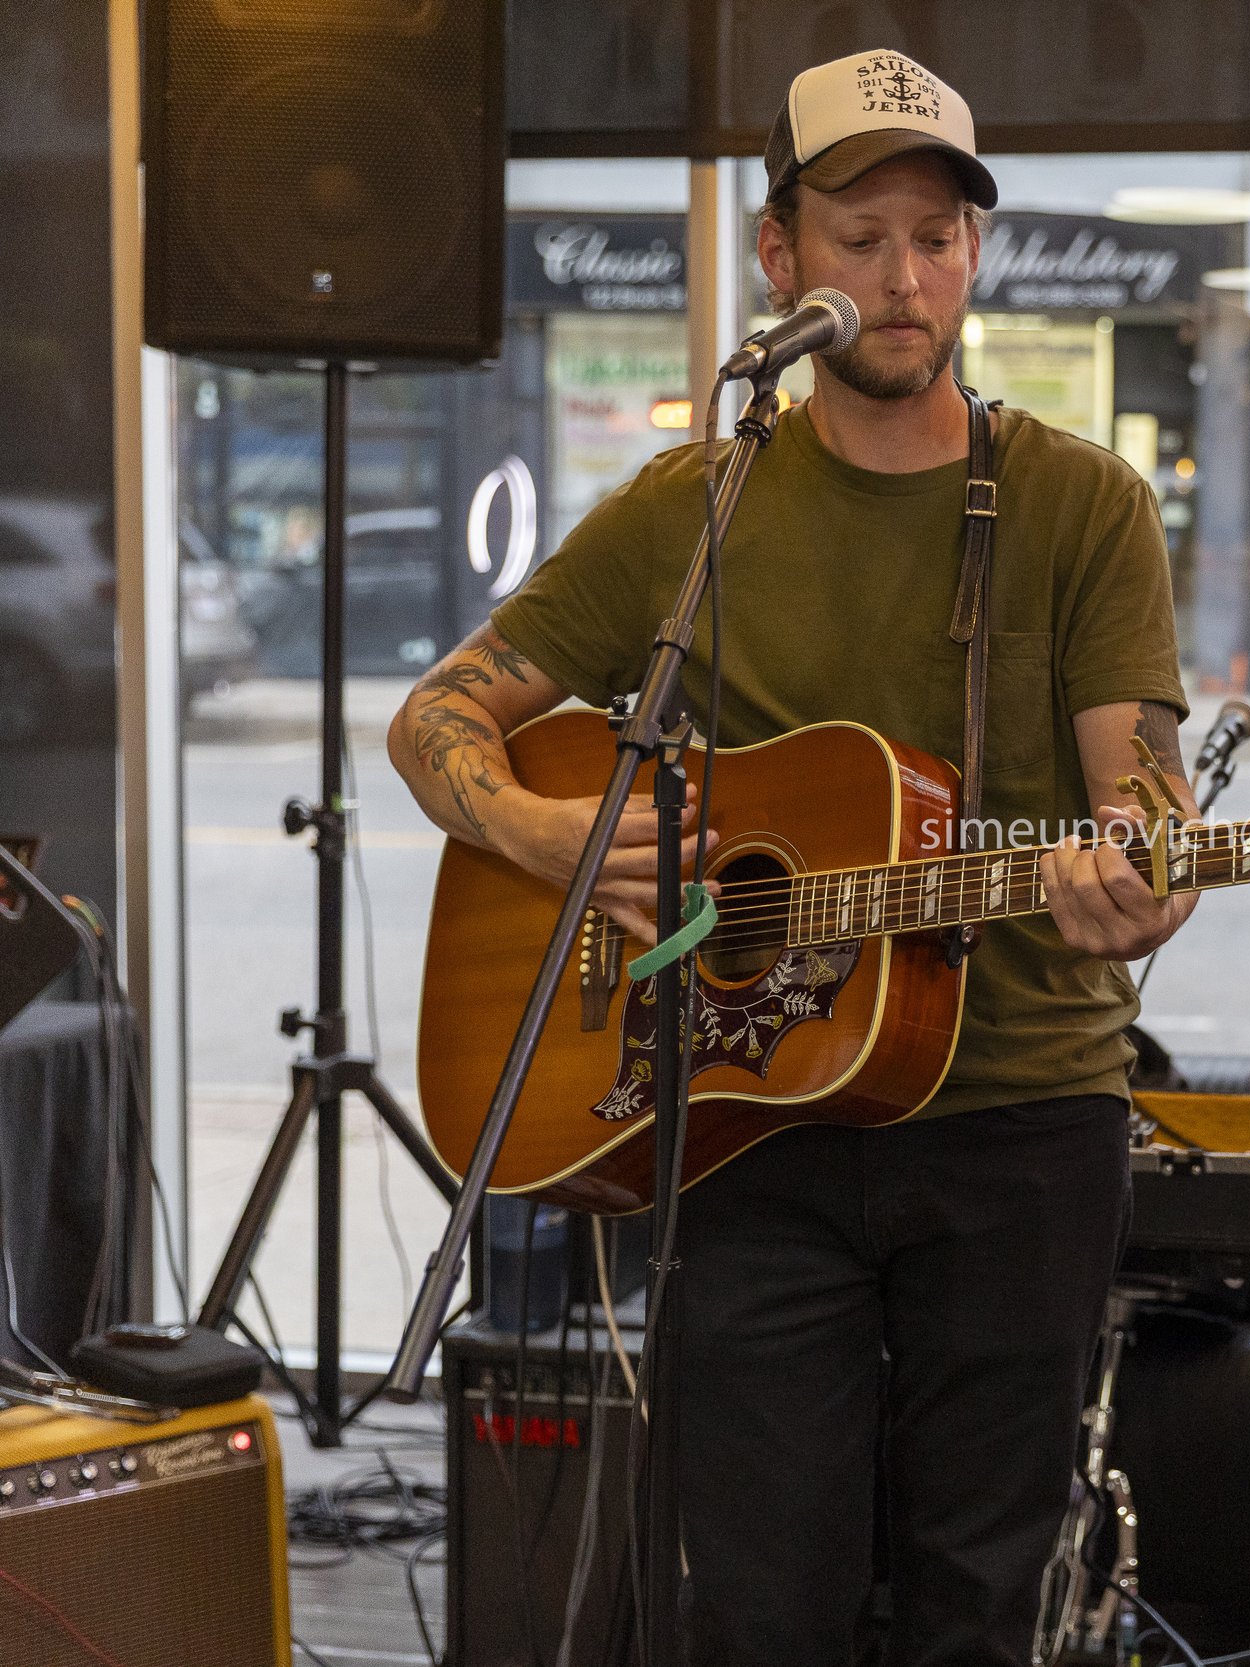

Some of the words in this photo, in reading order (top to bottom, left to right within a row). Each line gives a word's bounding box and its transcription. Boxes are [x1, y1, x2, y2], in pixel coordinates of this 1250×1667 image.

[868, 55, 884, 63] THE
[857, 60, 937, 89] SAILOR
[857, 78, 883, 90] 1911
[917, 83, 941, 100] 1973
[862, 100, 942, 121] JERRY
[533, 222, 682, 284] Classic
